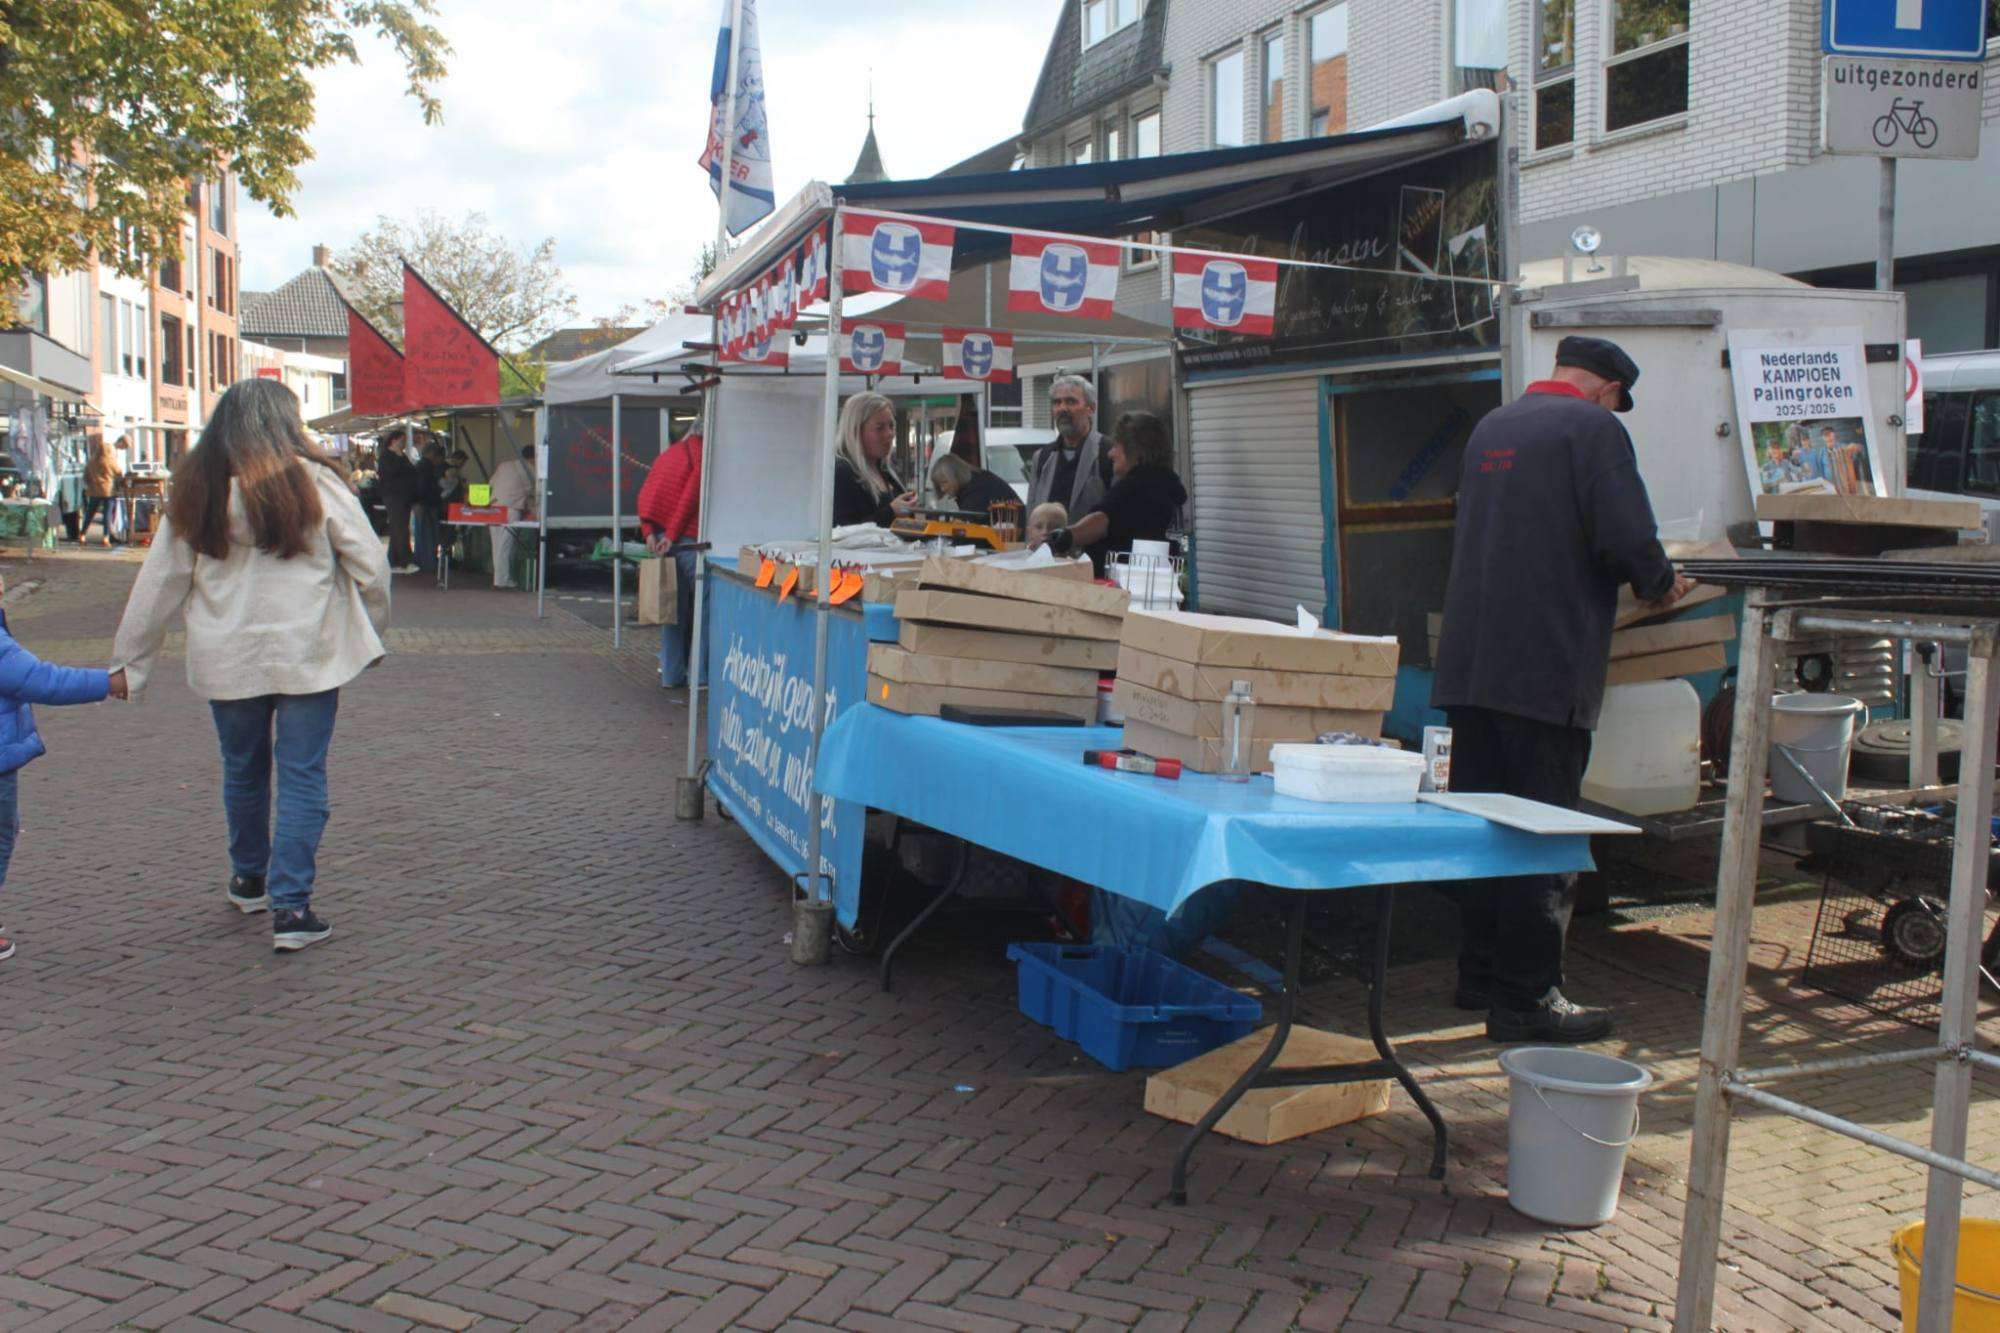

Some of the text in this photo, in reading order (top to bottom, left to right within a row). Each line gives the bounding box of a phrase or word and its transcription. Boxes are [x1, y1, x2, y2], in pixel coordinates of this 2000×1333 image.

[1834, 64, 1979, 92] uitgezonderd
[1760, 351, 1839, 367] Nederlands
[1763, 366, 1842, 385] KAMPIOEN
[1753, 384, 1853, 402] Palingroken
[1776, 402, 1837, 417] 2025/2026
